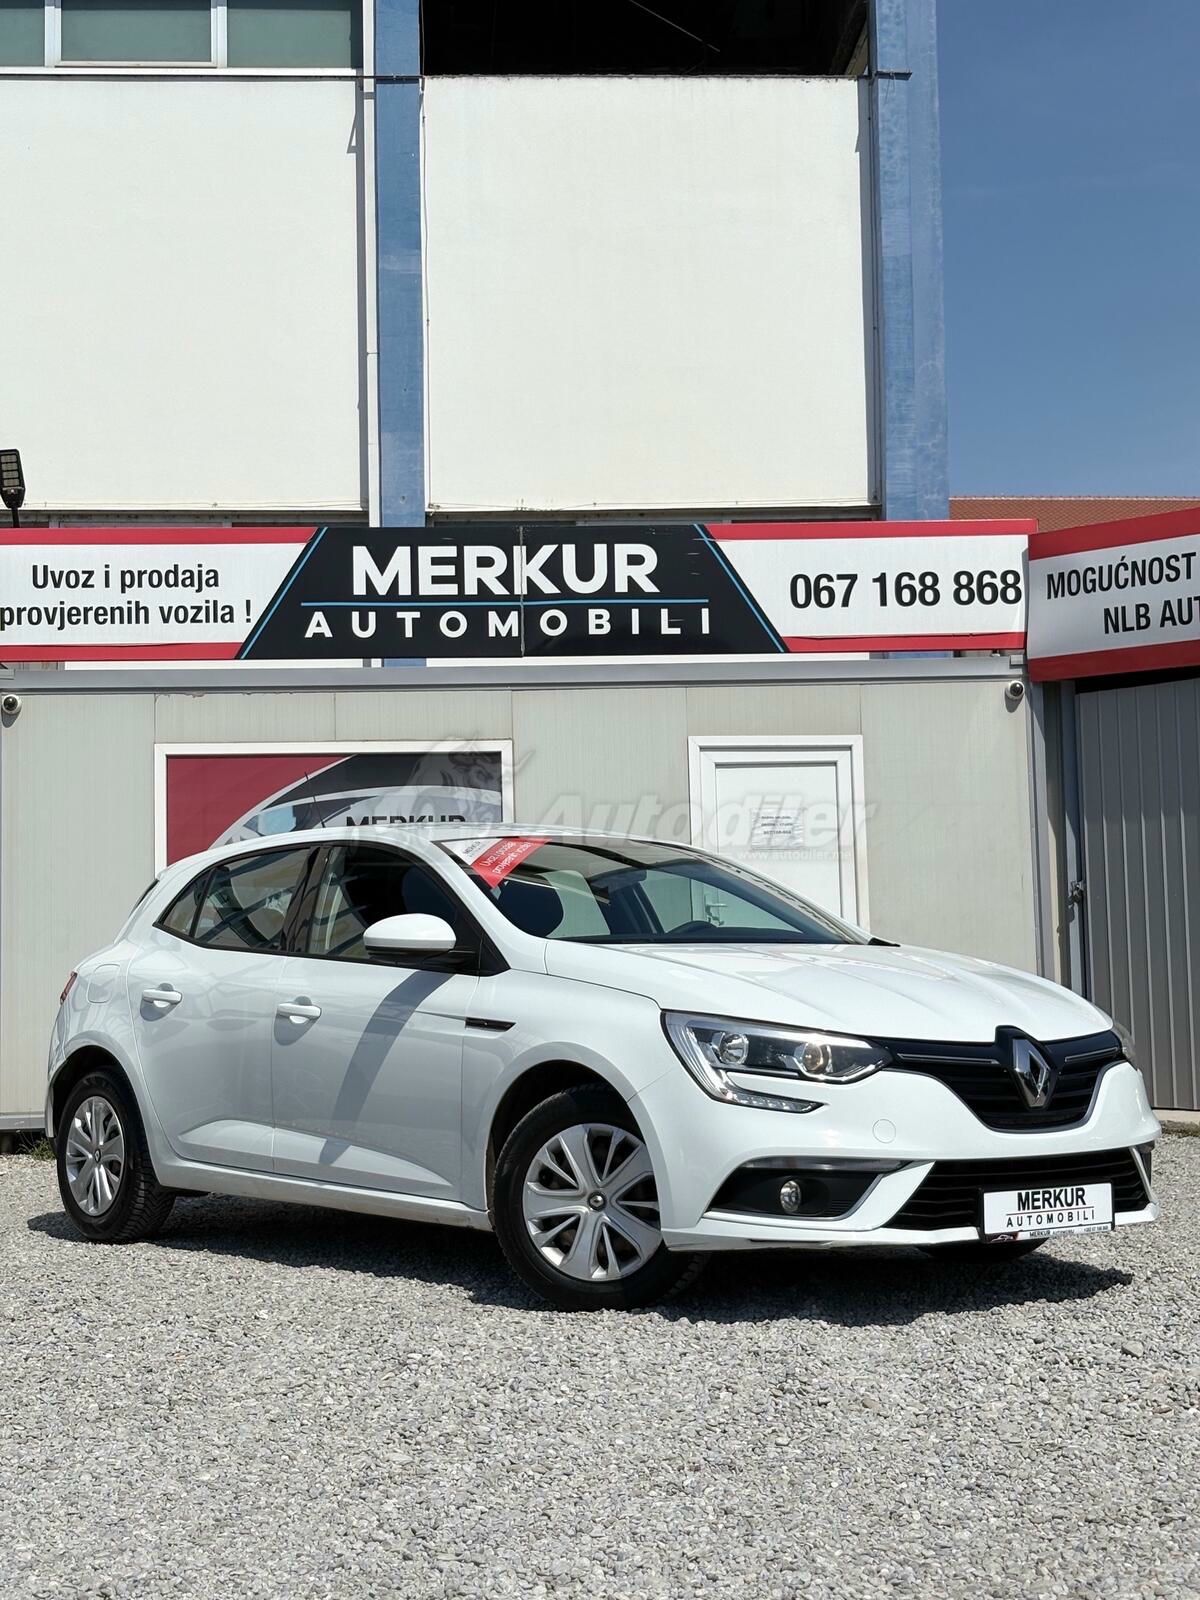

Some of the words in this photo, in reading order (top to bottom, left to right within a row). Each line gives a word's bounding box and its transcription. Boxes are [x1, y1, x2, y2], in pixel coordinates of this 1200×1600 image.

[32, 564, 95, 589] Uvoz
[104, 564, 110, 588] i
[120, 564, 219, 593] prodaja
[352, 543, 660, 595] MERKUR
[1047, 552, 1197, 600] MOGUĆNOST
[790, 574, 858, 608] 067
[872, 572, 941, 607] 168
[953, 570, 1022, 605] 868
[0, 601, 150, 631] provjerenih
[158, 600, 234, 624] vozila
[304, 607, 710, 639] AUTOMOBILI
[1103, 603, 1150, 634] NLB
[1017, 1187, 1086, 1212] MERKUR
[1006, 1209, 1095, 1228] AUTOMOBILI
